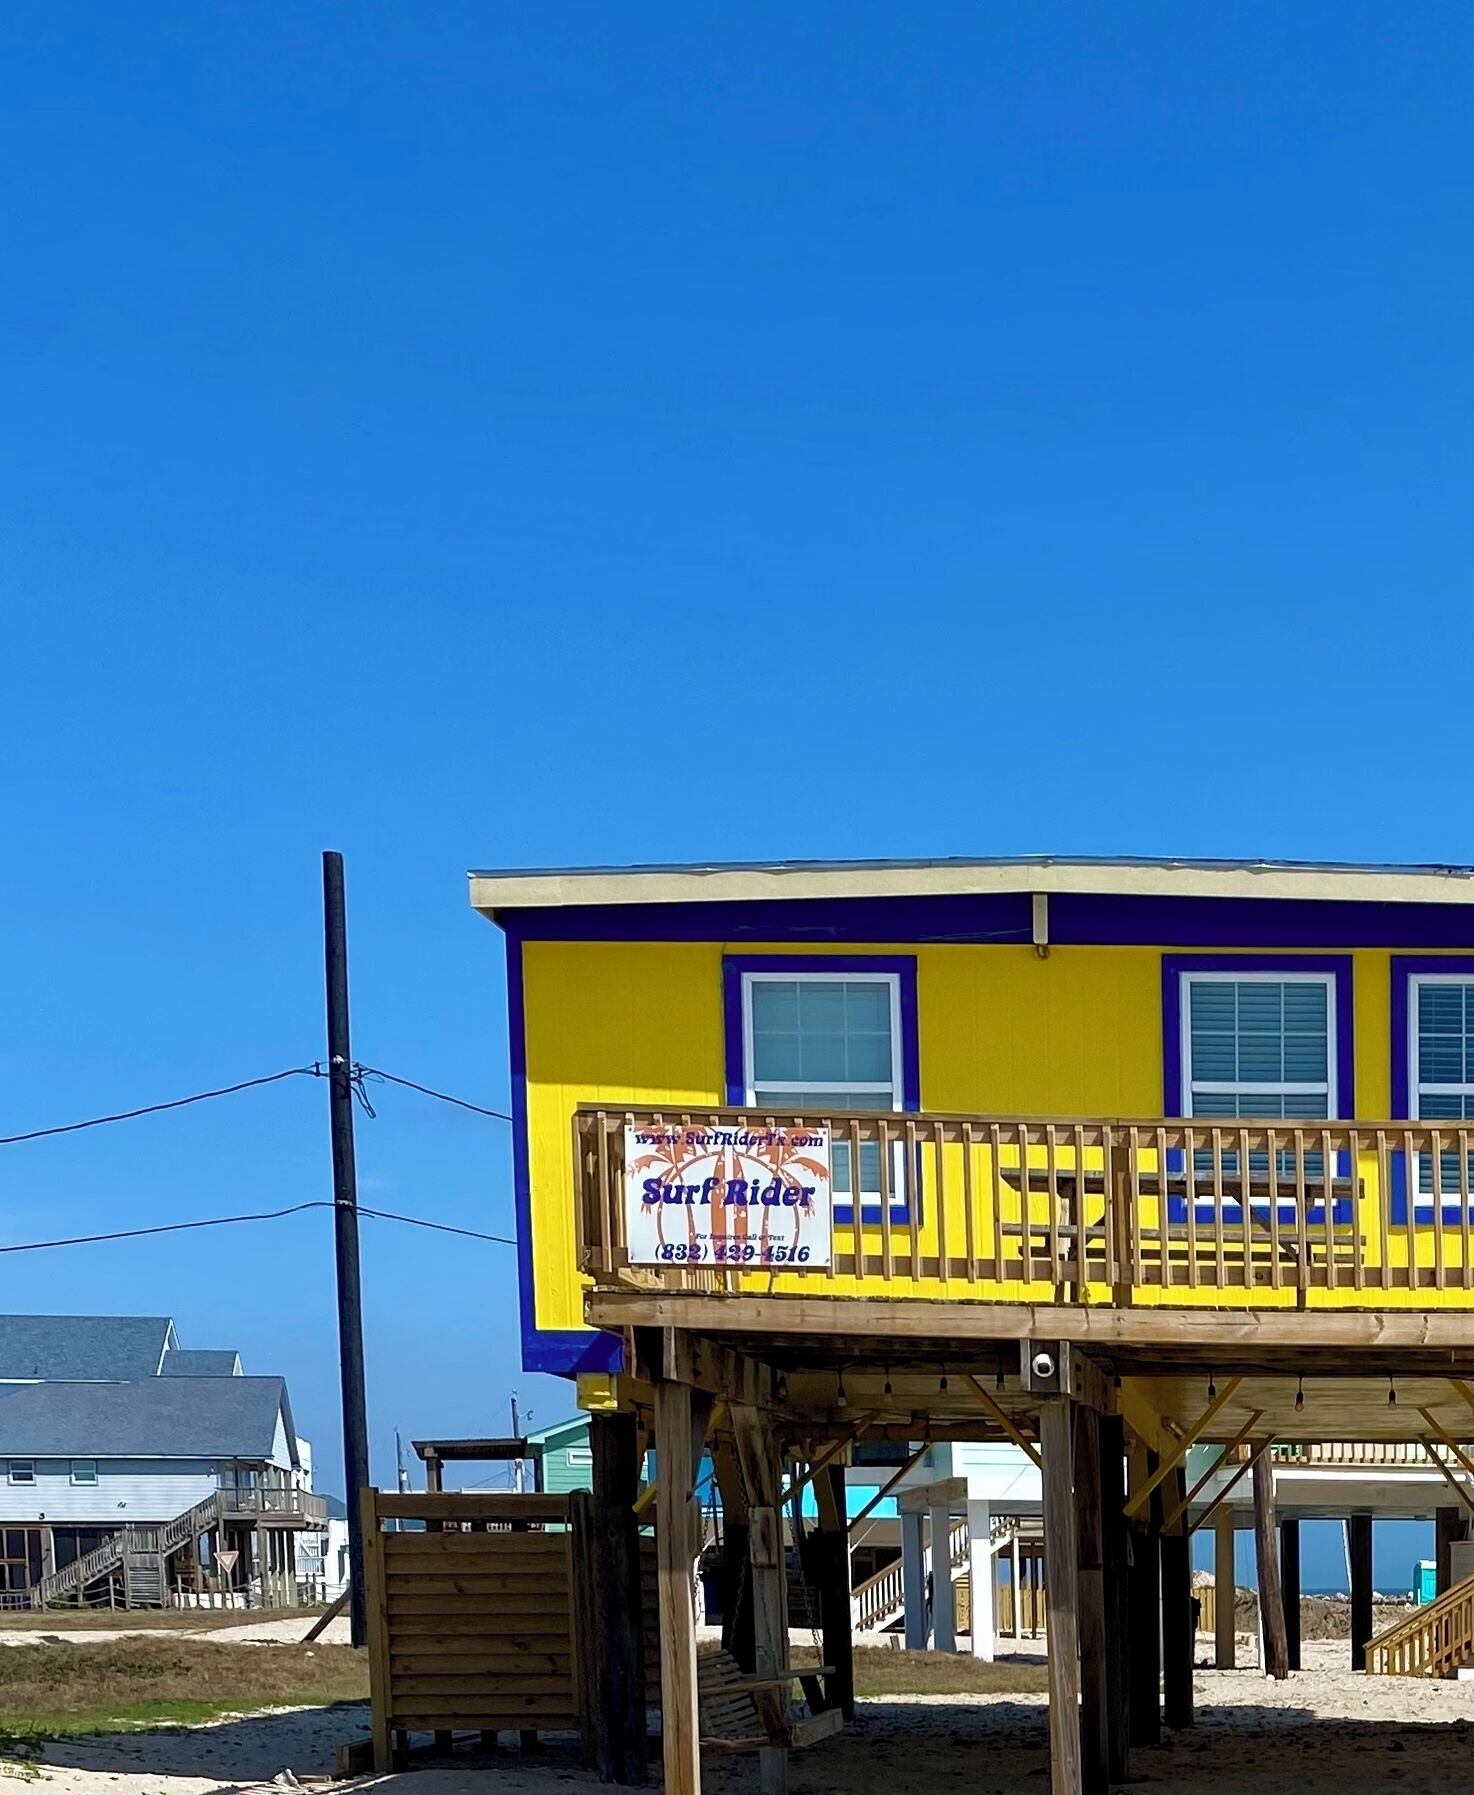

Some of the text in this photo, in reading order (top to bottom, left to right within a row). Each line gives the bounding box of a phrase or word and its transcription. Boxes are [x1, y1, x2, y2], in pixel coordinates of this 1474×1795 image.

[643, 1177, 816, 1207] Surf Rider
[655, 1243, 811, 1263] (832) 429-4516
